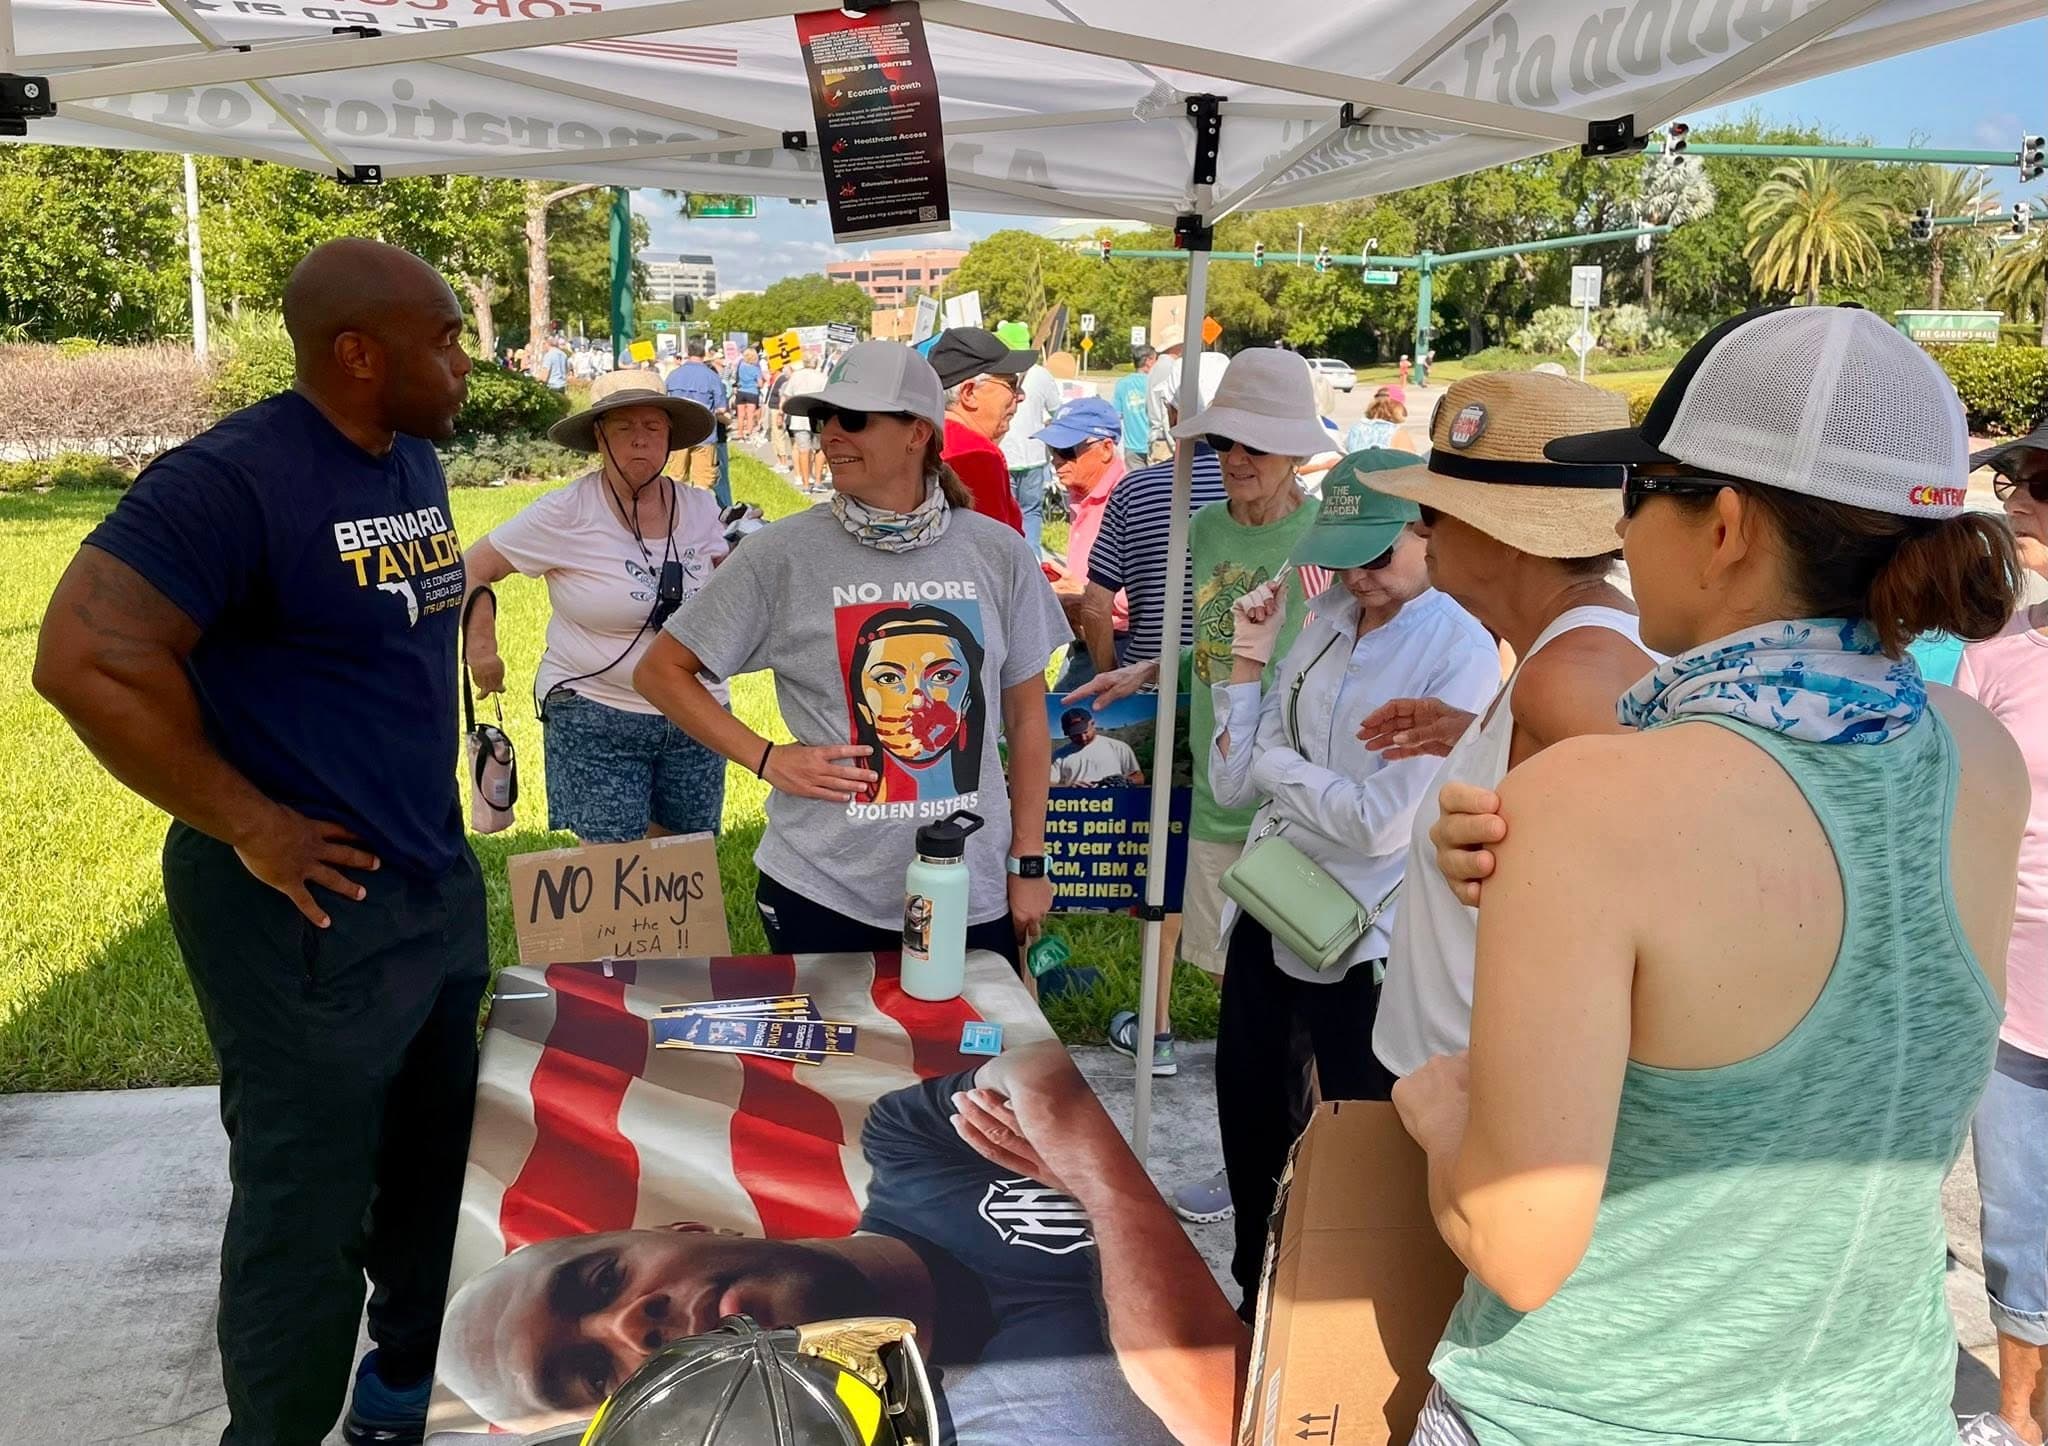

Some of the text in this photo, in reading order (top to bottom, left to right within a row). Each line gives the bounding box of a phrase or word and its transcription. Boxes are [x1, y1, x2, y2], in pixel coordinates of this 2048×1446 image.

[821, 60, 913, 75] BERNARD'S PRIORITIES
[847, 81, 921, 99] Economic Growth
[854, 132, 927, 145] Healthcare Access
[1933, 330, 1973, 339] GARDENS
[1332, 485, 1350, 495] THE
[1326, 495, 1361, 506] ICTORY
[334, 506, 448, 552] BERNARD
[340, 529, 460, 587] TAYLOR
[432, 569, 462, 587] CONGRESS
[425, 587, 449, 602] FLORIDA
[833, 580, 978, 606] NO MORE
[435, 600, 446, 612] UP
[446, 597, 454, 609] TO
[846, 793, 978, 821] STOLEN SISTERS
[1083, 819, 1126, 836] paid
[1068, 842, 1112, 857] year
[1092, 862, 1128, 877] IBM
[1134, 862, 1148, 877] &
[530, 865, 593, 923] NO
[632, 917, 659, 932] the
[614, 935, 661, 957] USA
[767, 1022, 783, 1047] TAYLOR
